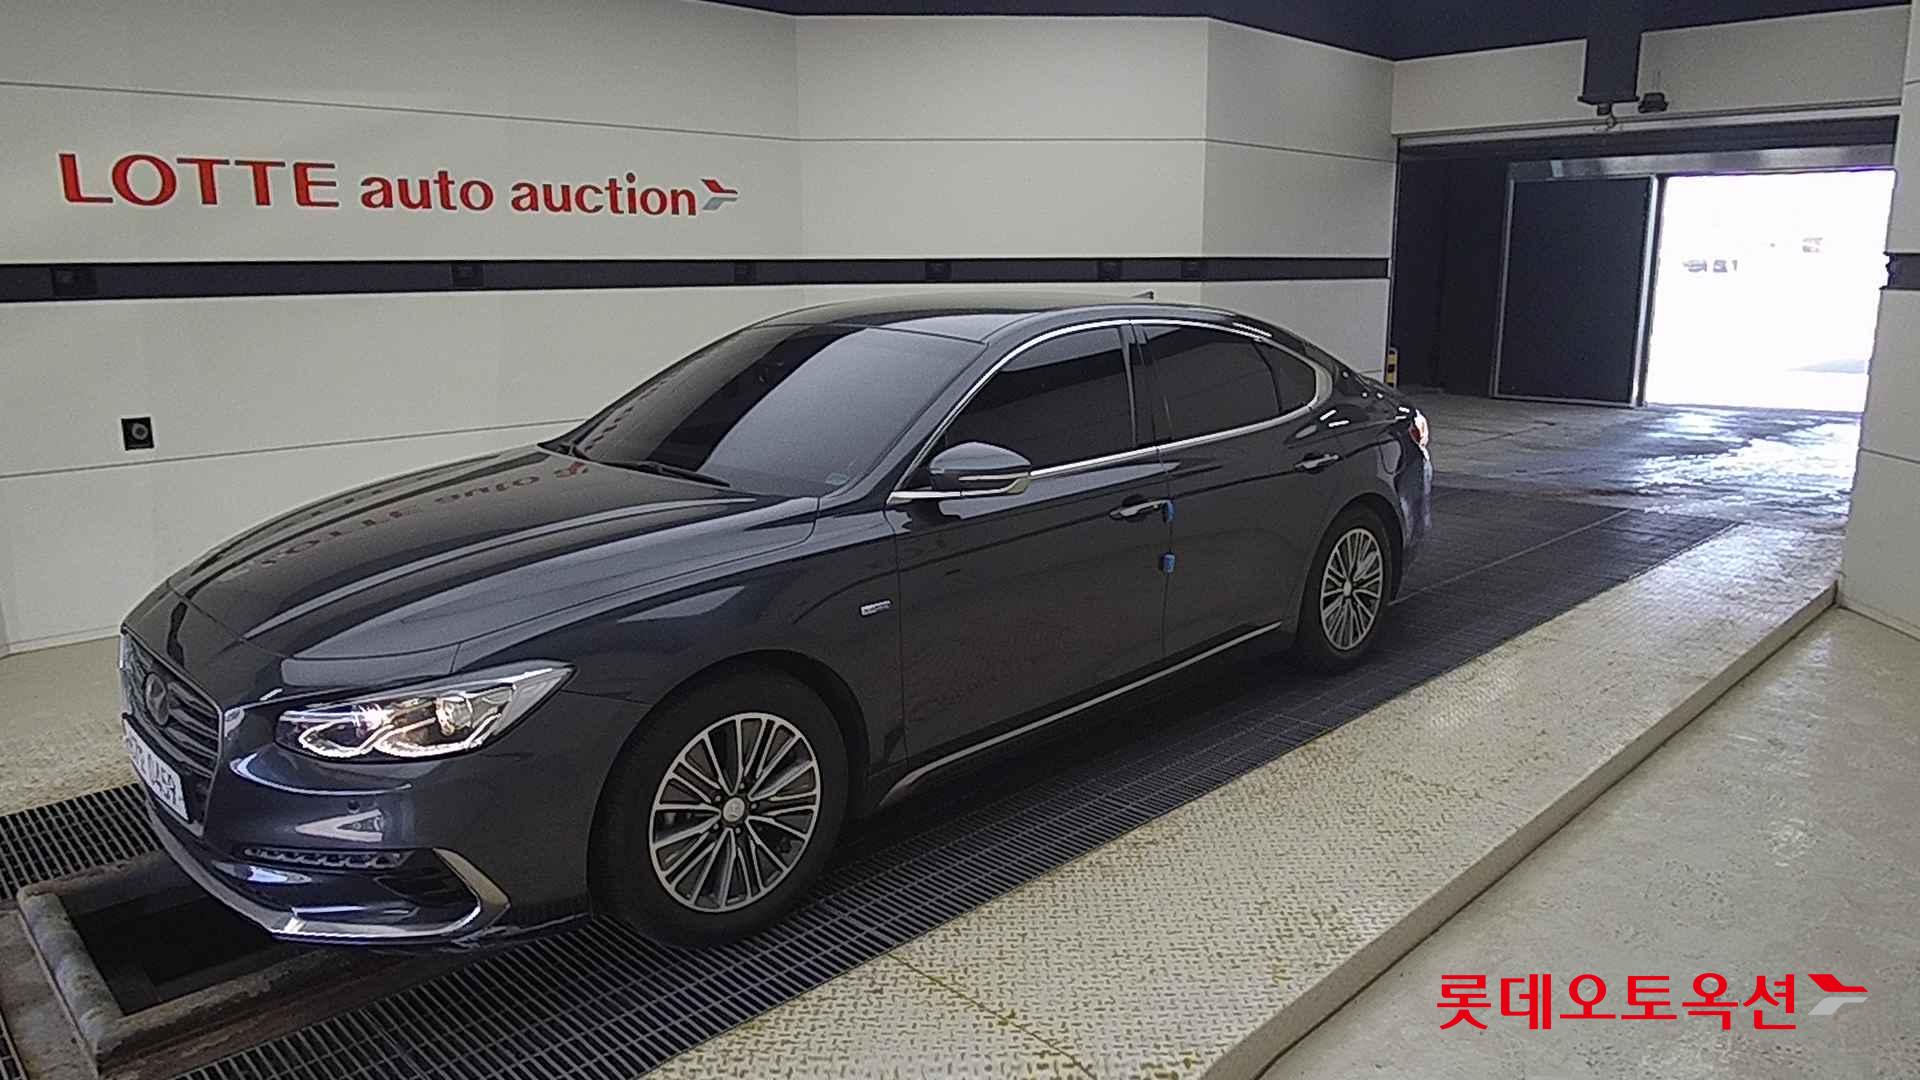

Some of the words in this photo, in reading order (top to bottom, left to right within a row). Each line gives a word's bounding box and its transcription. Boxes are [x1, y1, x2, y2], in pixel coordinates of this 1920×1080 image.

[59, 153, 338, 209] LOTTE
[360, 170, 493, 211] auto
[510, 171, 697, 216] auction
